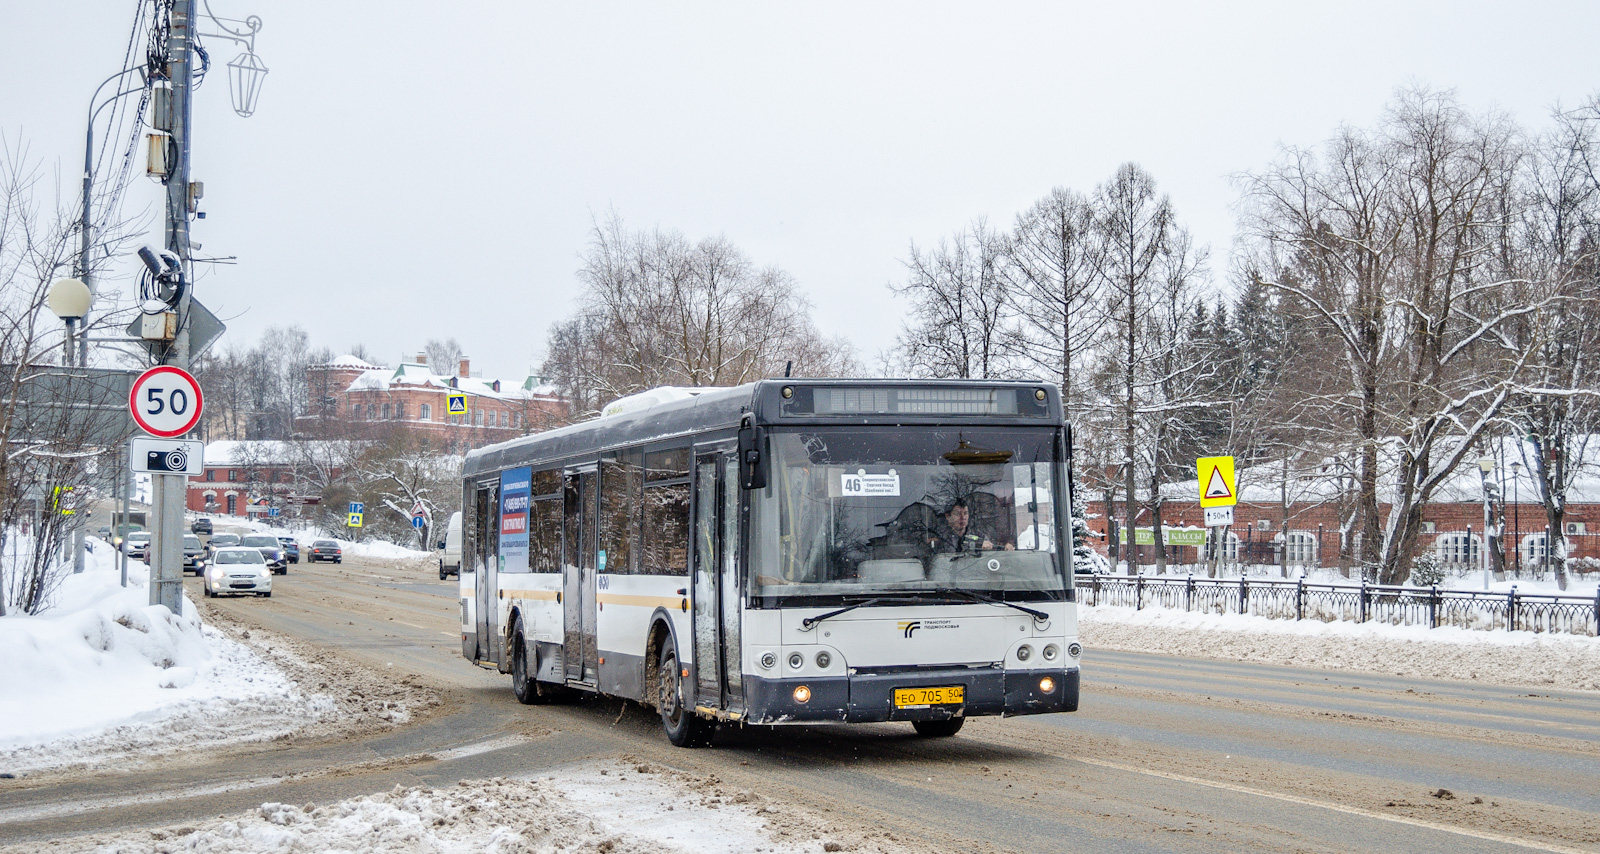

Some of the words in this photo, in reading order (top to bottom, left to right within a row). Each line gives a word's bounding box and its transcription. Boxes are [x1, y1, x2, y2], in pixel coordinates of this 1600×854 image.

[147, 388, 188, 415] 50
[845, 478, 861, 492] 46
[1171, 532, 1202, 540] КЛАССЫ
[920, 690, 943, 702] 705
[948, 688, 959, 698] 50
